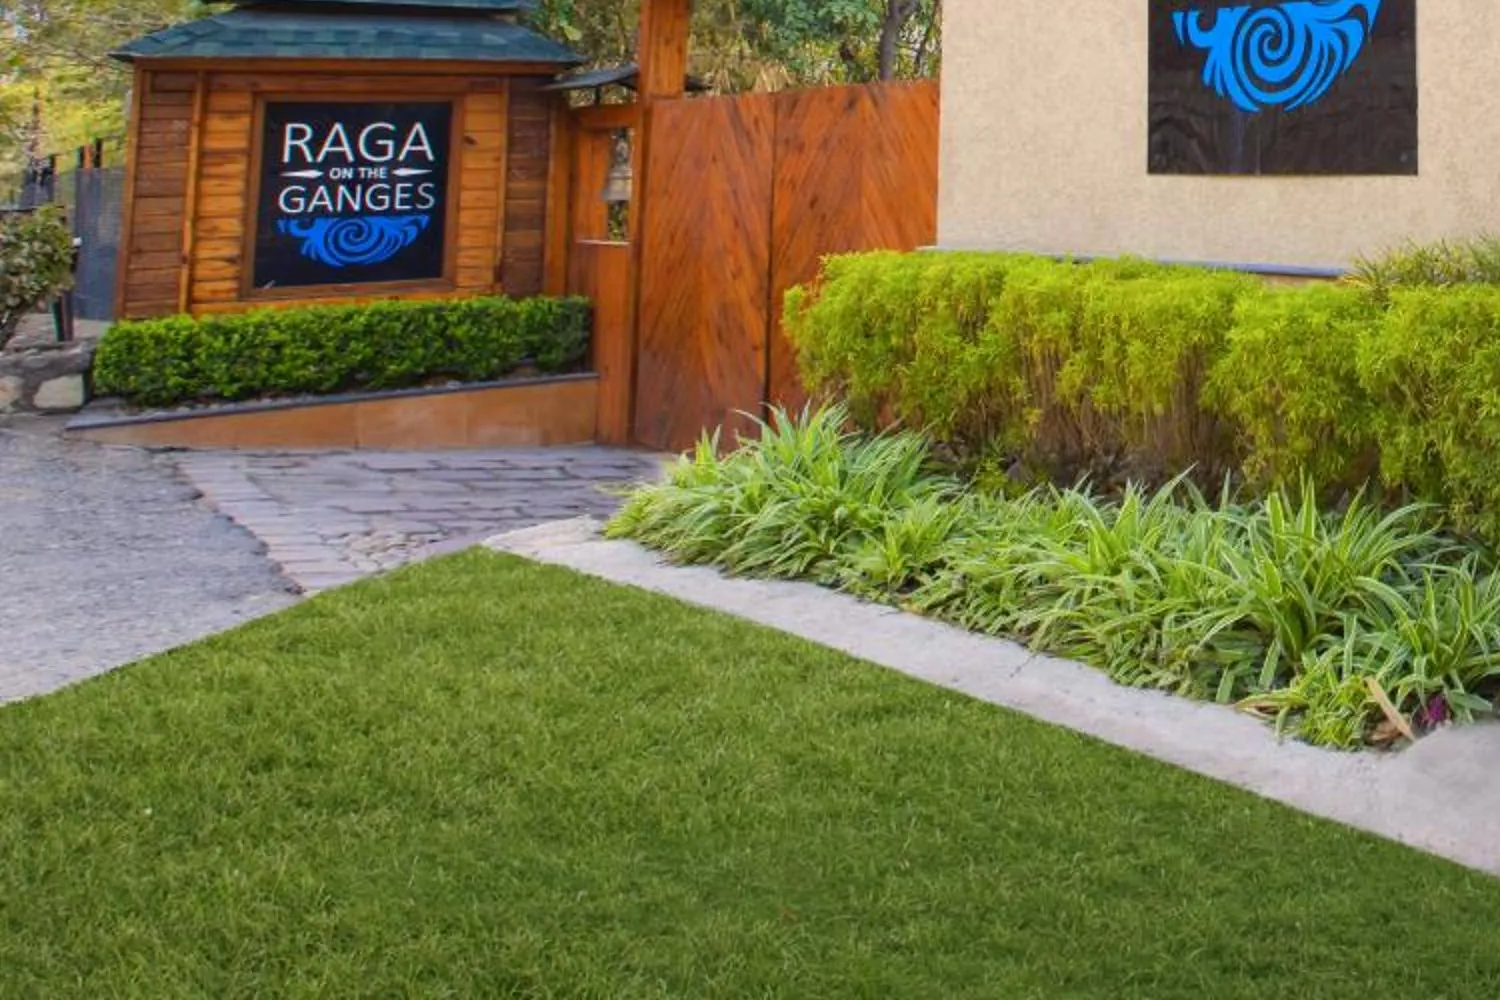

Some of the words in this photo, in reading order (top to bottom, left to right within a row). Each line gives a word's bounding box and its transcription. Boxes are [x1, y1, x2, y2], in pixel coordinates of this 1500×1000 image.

[282, 121, 435, 163] RAGA
[329, 167, 354, 180] ON
[358, 167, 388, 179] THE
[278, 182, 436, 214] GANGES
